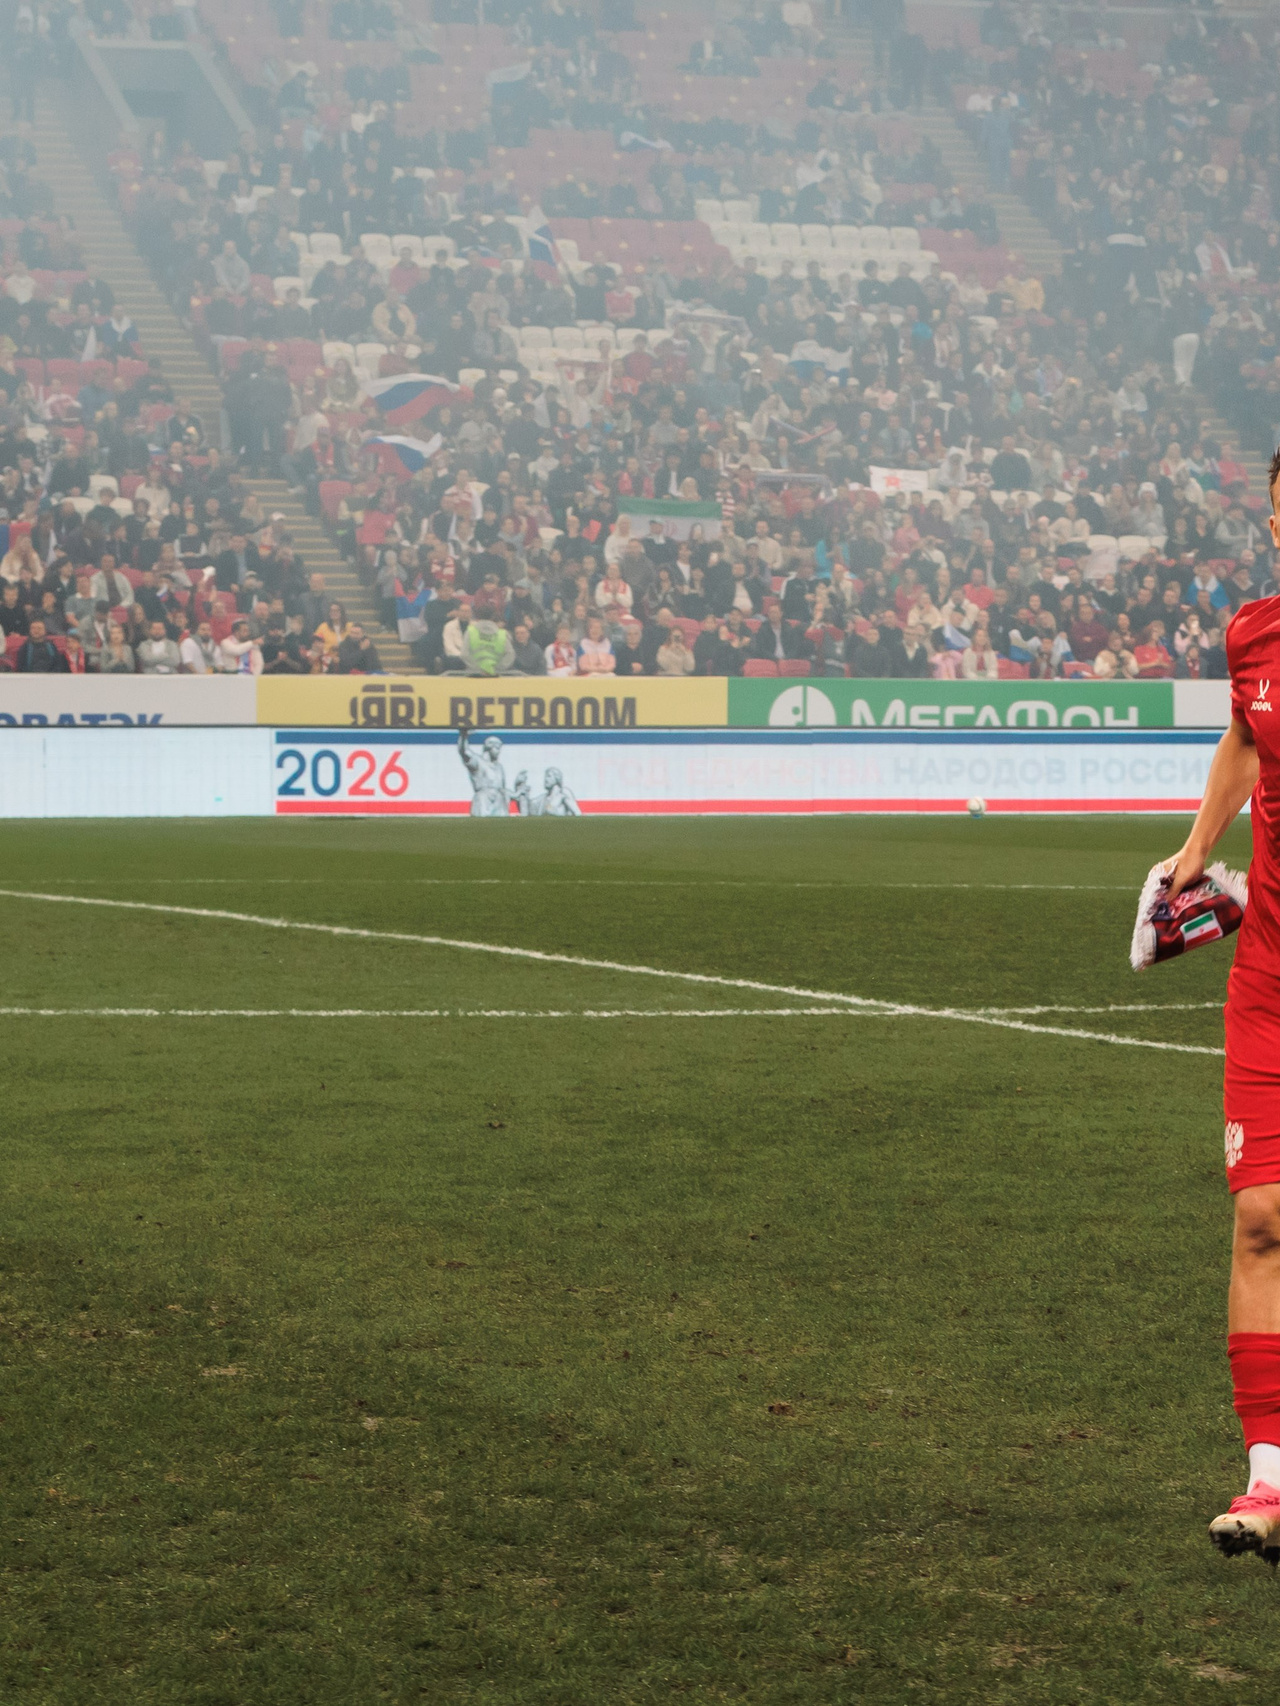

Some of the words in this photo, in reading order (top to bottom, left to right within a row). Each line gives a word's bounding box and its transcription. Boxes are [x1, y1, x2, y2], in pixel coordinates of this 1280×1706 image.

[276, 749, 409, 797] 2026
[893, 756, 1067, 788] НАРОДОВ
[1080, 757, 1211, 786] РОССИ
